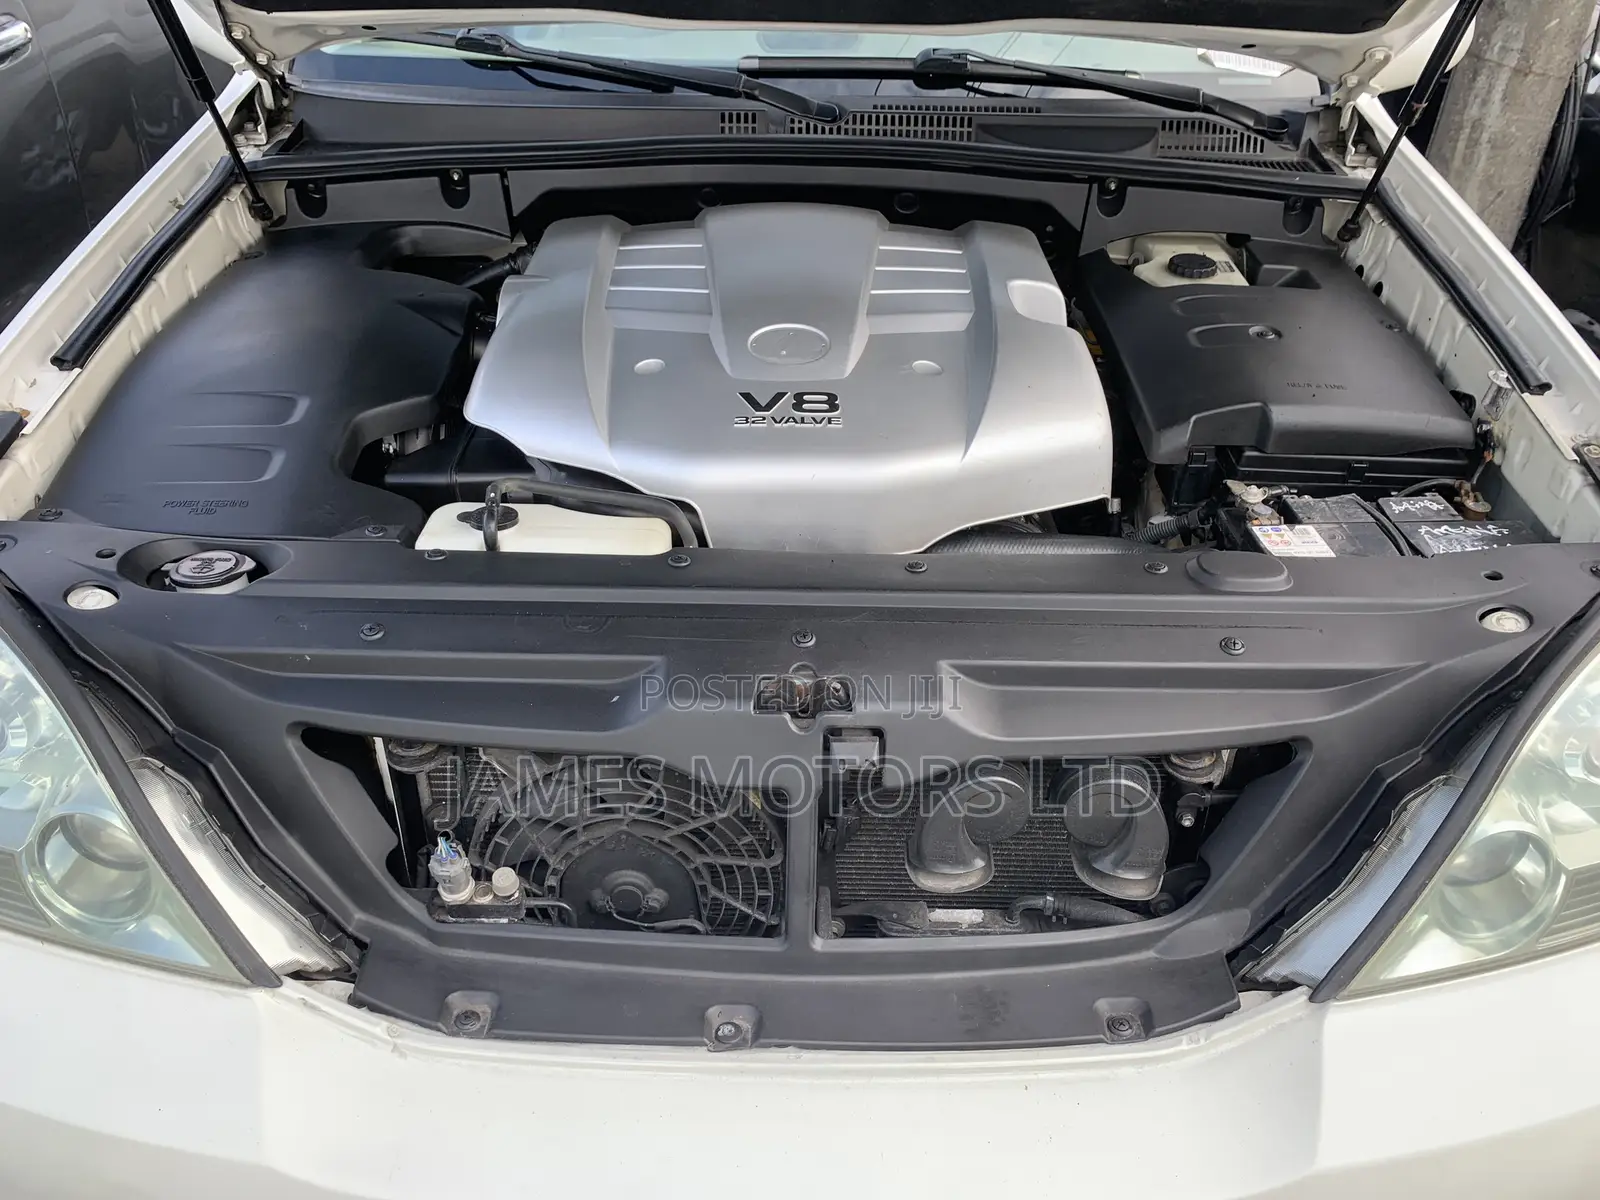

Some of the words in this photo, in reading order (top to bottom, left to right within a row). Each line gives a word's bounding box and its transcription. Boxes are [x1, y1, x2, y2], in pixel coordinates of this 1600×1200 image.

[736, 391, 840, 414] V8
[733, 416, 767, 427] 32
[770, 416, 843, 427] VALVE
[162, 500, 200, 508] POWER
[201, 500, 249, 508] STEERING
